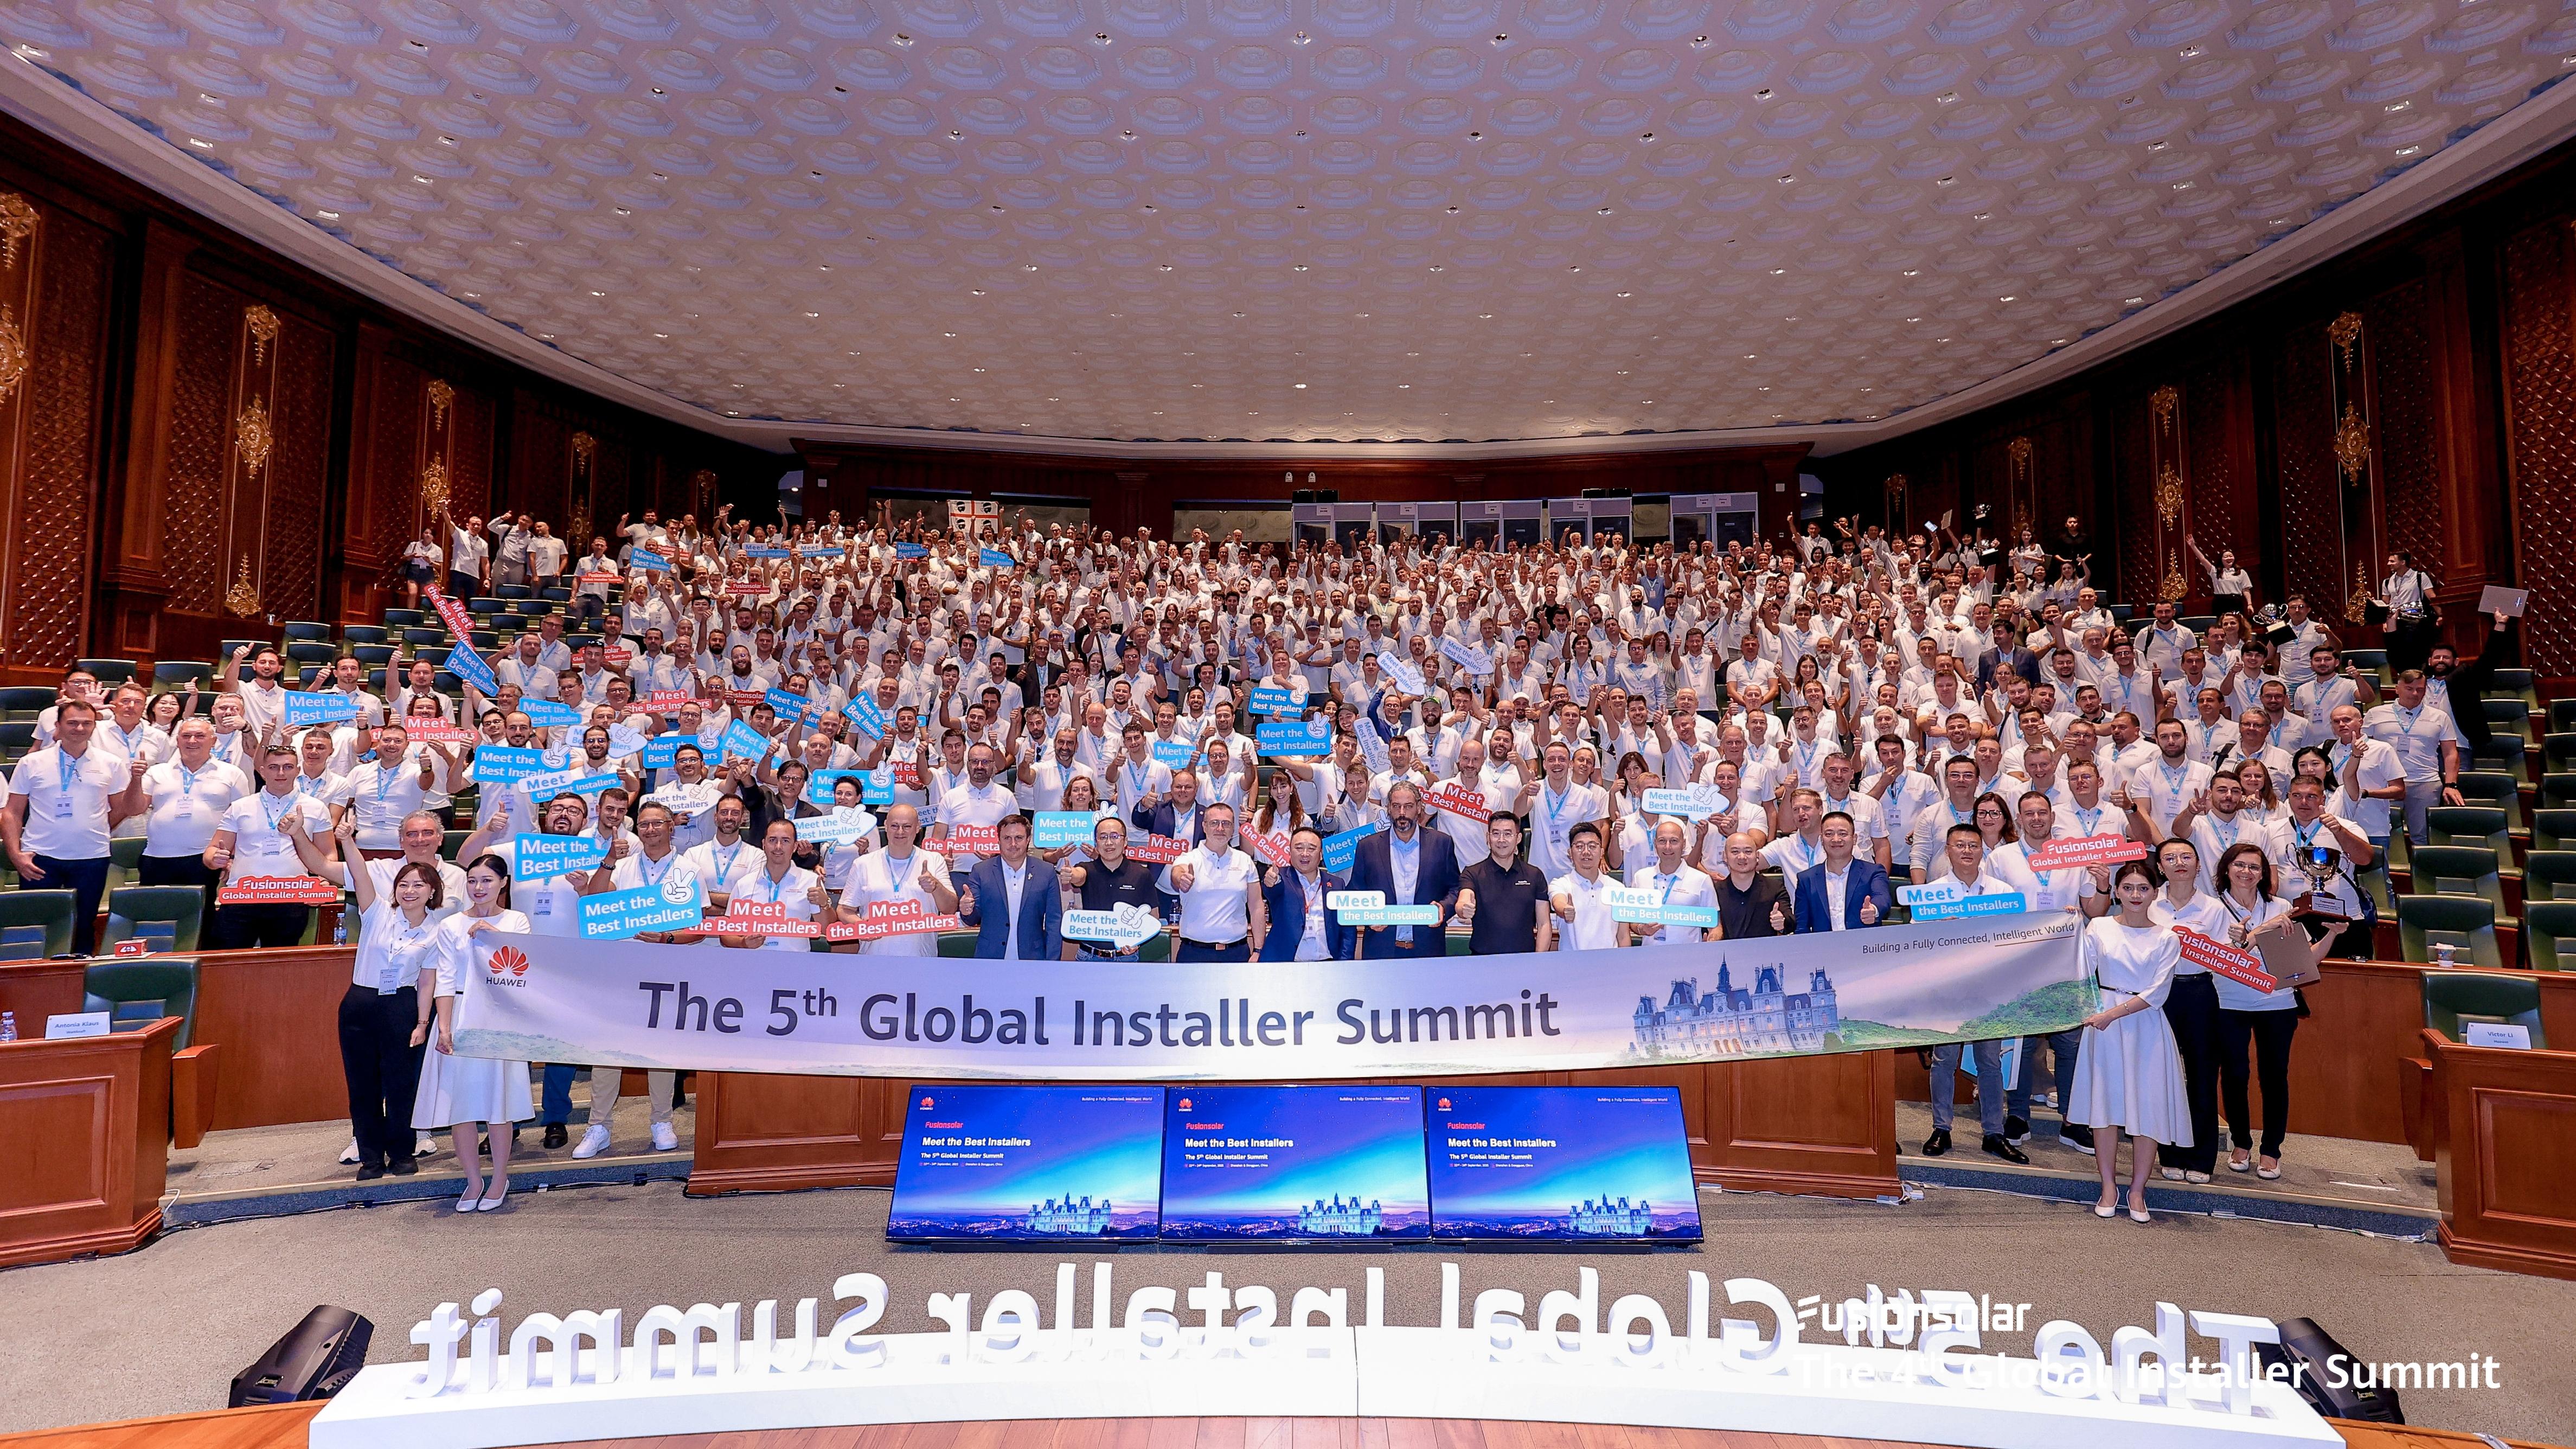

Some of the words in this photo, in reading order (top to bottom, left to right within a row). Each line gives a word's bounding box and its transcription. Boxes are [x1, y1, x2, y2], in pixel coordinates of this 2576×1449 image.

[635, 551, 652, 560] Meet
[633, 559, 649, 567] Best
[290, 695, 325, 707] Meet
[655, 691, 685, 700] Meet
[769, 693, 791, 704] Meet
[523, 702, 551, 713] Meet
[1270, 704, 1302, 712] Installers
[291, 710, 321, 722] Best
[408, 719, 446, 728] Meet
[1261, 730, 1285, 738] Meet
[1157, 746, 1182, 755] Meet
[1284, 741, 1326, 749] Installers
[480, 752, 512, 762] Meet
[516, 754, 535, 764] the
[648, 754, 669, 762] Best
[479, 765, 504, 776] Best
[527, 775, 566, 791] Meet
[576, 777, 617, 791] Installers
[1447, 785, 1482, 805] Meet
[1649, 792, 1673, 800] Meet
[1676, 793, 1690, 802] the
[668, 802, 708, 810] Installers
[1432, 794, 1454, 809] Best
[1671, 803, 1713, 812] Installers
[796, 819, 821, 829] Meet
[823, 818, 838, 828] the
[1040, 819, 1067, 828] Meet
[1071, 818, 1087, 828] the
[818, 826, 861, 837] Installers
[959, 828, 995, 837] Meet
[1039, 832, 1061, 841] Best
[522, 839, 566, 854] Meet
[570, 841, 588, 852] the
[925, 842, 943, 850] the
[1151, 837, 1187, 851] Meet
[1325, 839, 1353, 853] Meet
[2048, 838, 2118, 855] Fusionsolar
[1138, 851, 1161, 860] Best
[1330, 853, 1353, 866] Best
[2032, 856, 2062, 867] Global
[2064, 852, 2102, 863] Installer
[2105, 848, 2143, 858] Summit
[522, 858, 559, 875] Best
[243, 879, 315, 890] Fusionsolar
[1336, 895, 1377, 907] Meet
[1611, 890, 1654, 905] Meet
[1906, 888, 1954, 902] Meet
[585, 901, 626, 917] Meet
[630, 895, 656, 909] the
[733, 902, 783, 917] Meet
[872, 902, 919, 918] Meet
[1919, 905, 1937, 915] the
[1940, 903, 1965, 914] Best
[1968, 899, 2019, 912] Installers
[587, 921, 620, 935] Best
[625, 907, 695, 929] Installers
[1070, 914, 1097, 923] Meet
[1101, 915, 1118, 925] the
[1344, 912, 1360, 920] the
[1619, 909, 1636, 918] the
[1639, 909, 1661, 919] Best
[1664, 911, 1712, 922] Installers
[717, 921, 749, 932] Best
[752, 920, 818, 935] Installers
[829, 925, 854, 938] the
[858, 922, 889, 936] Best
[892, 914, 955, 932] Installers
[1069, 925, 1092, 935] Best
[1095, 927, 1142, 938] Installers
[1862, 943, 1900, 954] Building
[1913, 939, 1934, 949] Fully
[1938, 933, 1990, 947] Connected,
[1993, 928, 2043, 941] Intelligent
[2045, 922, 2074, 933] World
[2186, 948, 2228, 970] Installer
[2229, 966, 2272, 989] Summit
[486, 976, 527, 988] HUAWEI
[638, 982, 744, 1035] The
[765, 986, 837, 1037] 5th
[860, 992, 1045, 1046] Global
[1074, 998, 1314, 1048] Installer
[1336, 989, 1561, 1045] Summit
[922, 1137, 945, 1146] Meet
[947, 1138, 962, 1146] the
[964, 1138, 986, 1146] Best
[988, 1138, 1031, 1146] Installers
[1186, 1139, 1208, 1147] Meet
[1210, 1139, 1225, 1147] the
[1227, 1139, 1248, 1147] Best
[1251, 1139, 1293, 1147] Installers
[1448, 1138, 1471, 1147] Meet
[1472, 1139, 1488, 1147] the
[1490, 1139, 1511, 1147] Best
[1514, 1138, 1556, 1147] Installers
